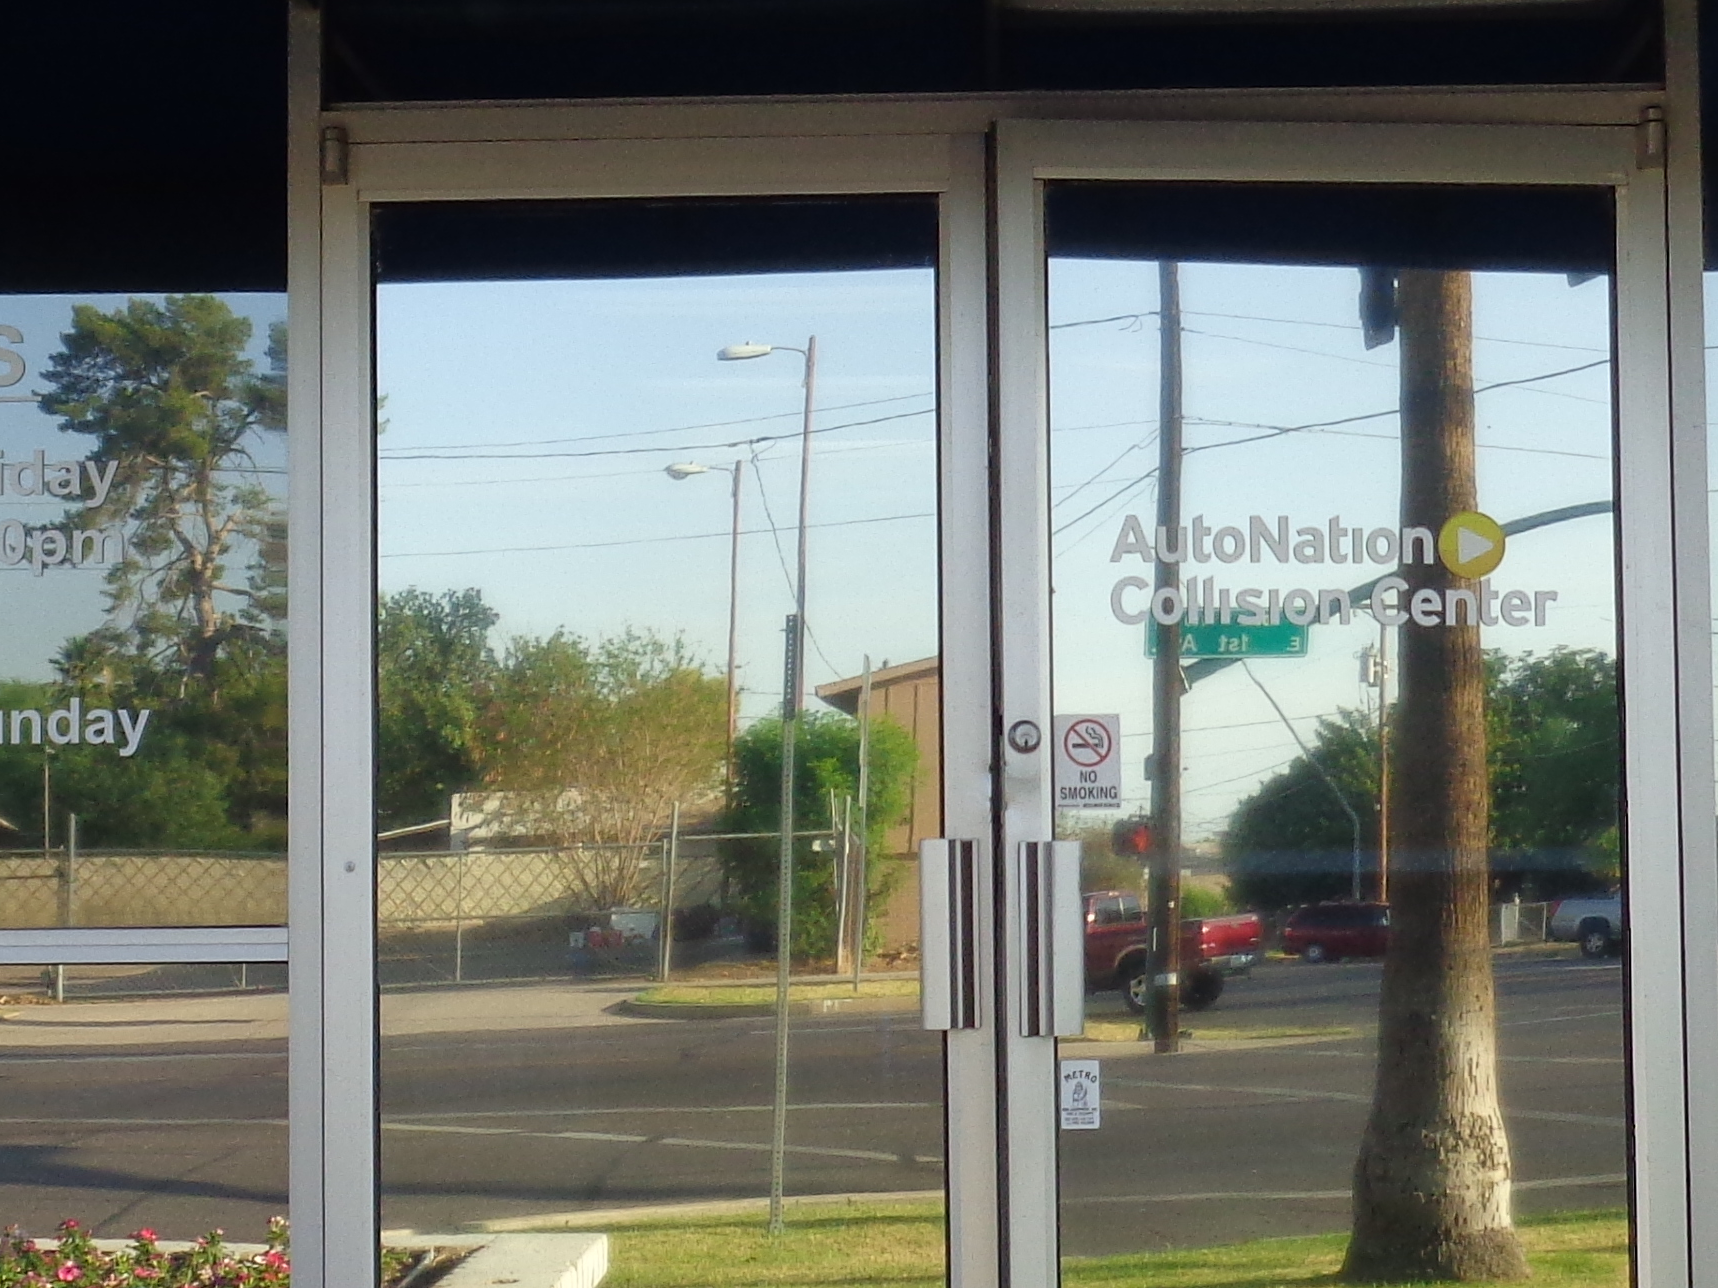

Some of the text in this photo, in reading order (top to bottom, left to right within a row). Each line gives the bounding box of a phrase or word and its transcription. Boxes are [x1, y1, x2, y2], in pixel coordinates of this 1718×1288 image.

[1110, 514, 1434, 564] AutoNation
[1110, 576, 1559, 627] Collision Center
[1080, 770, 1098, 783] NO
[1060, 786, 1117, 800] SMOKING
[1064, 1070, 1097, 1083] METRO
